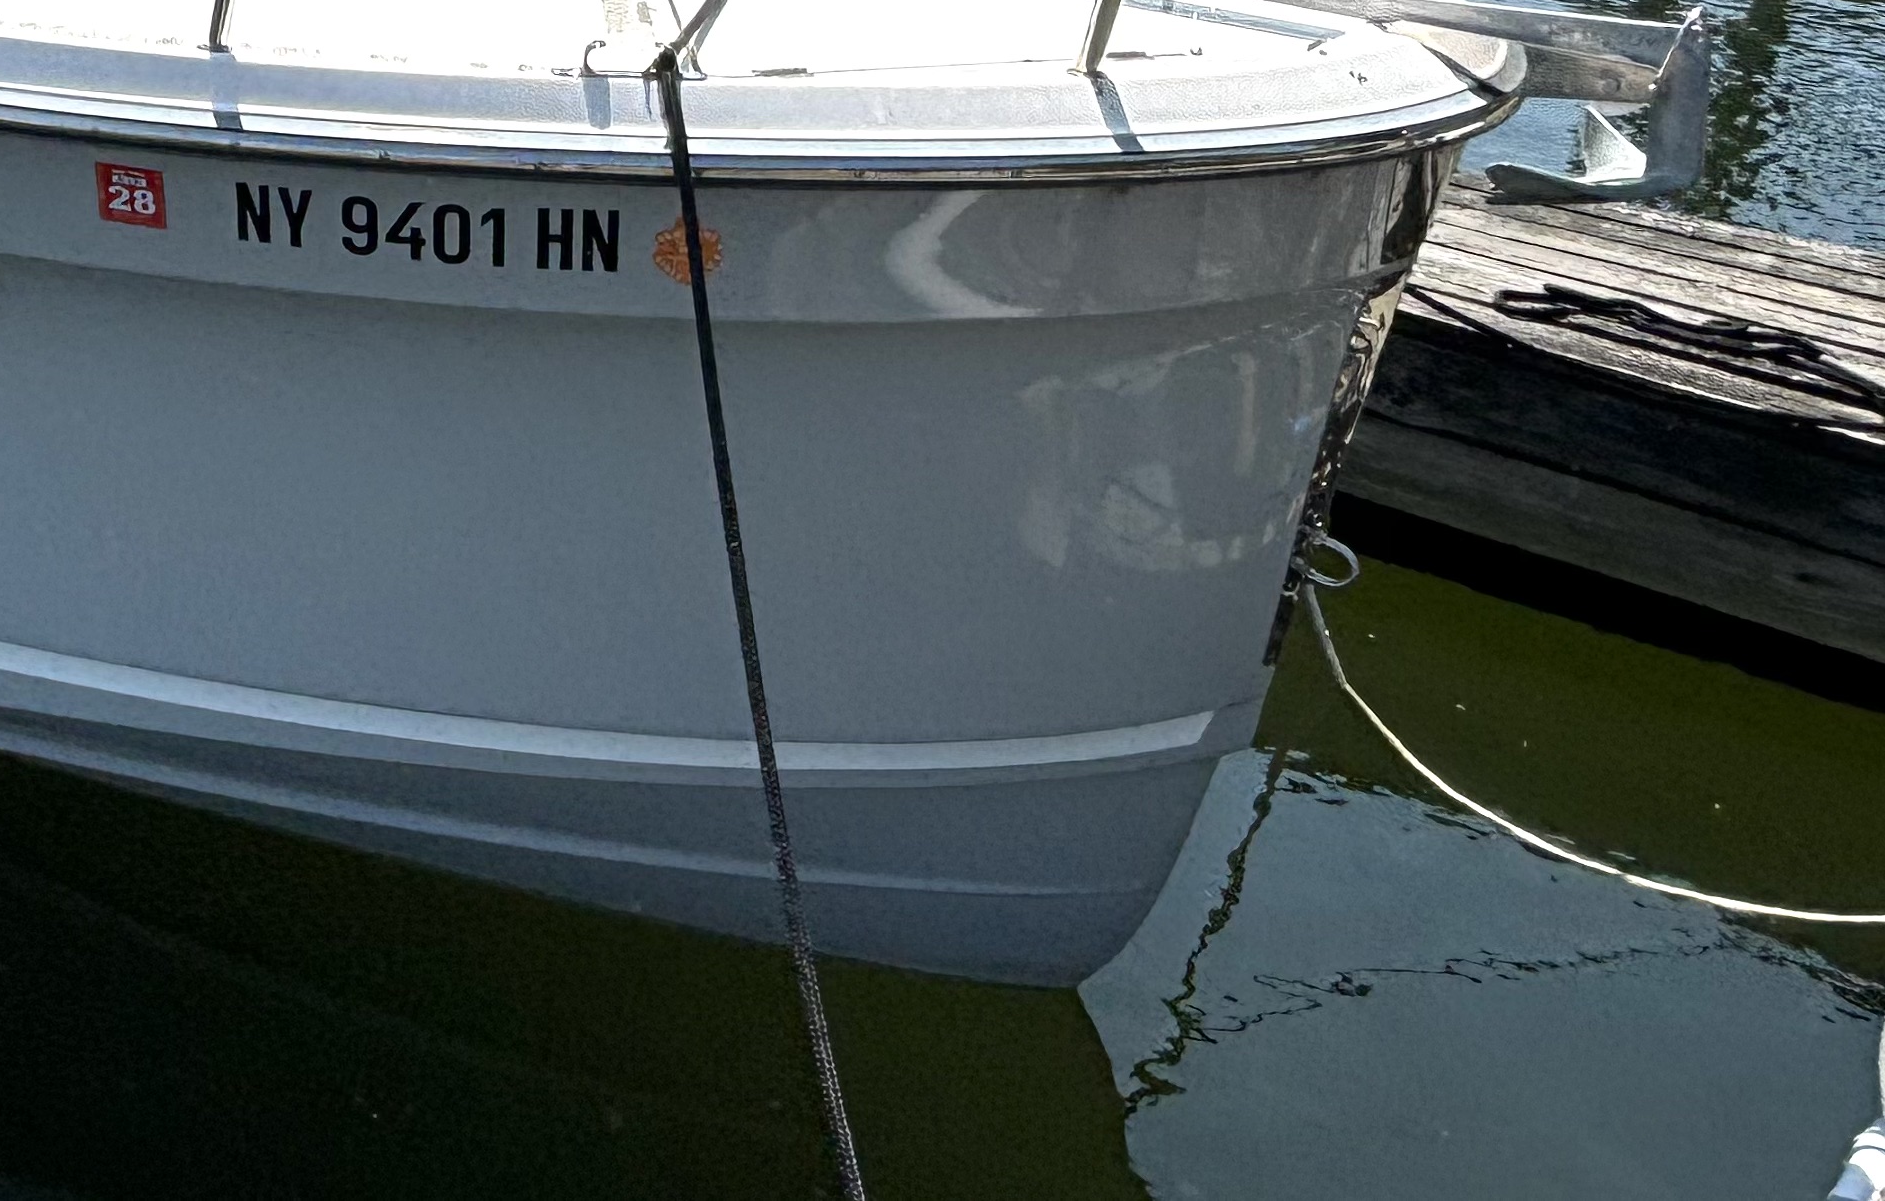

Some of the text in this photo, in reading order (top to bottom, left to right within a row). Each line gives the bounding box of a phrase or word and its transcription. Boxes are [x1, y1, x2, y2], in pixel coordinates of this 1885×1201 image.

[108, 185, 156, 215] 28
[235, 182, 620, 272] NY 9401 HN
